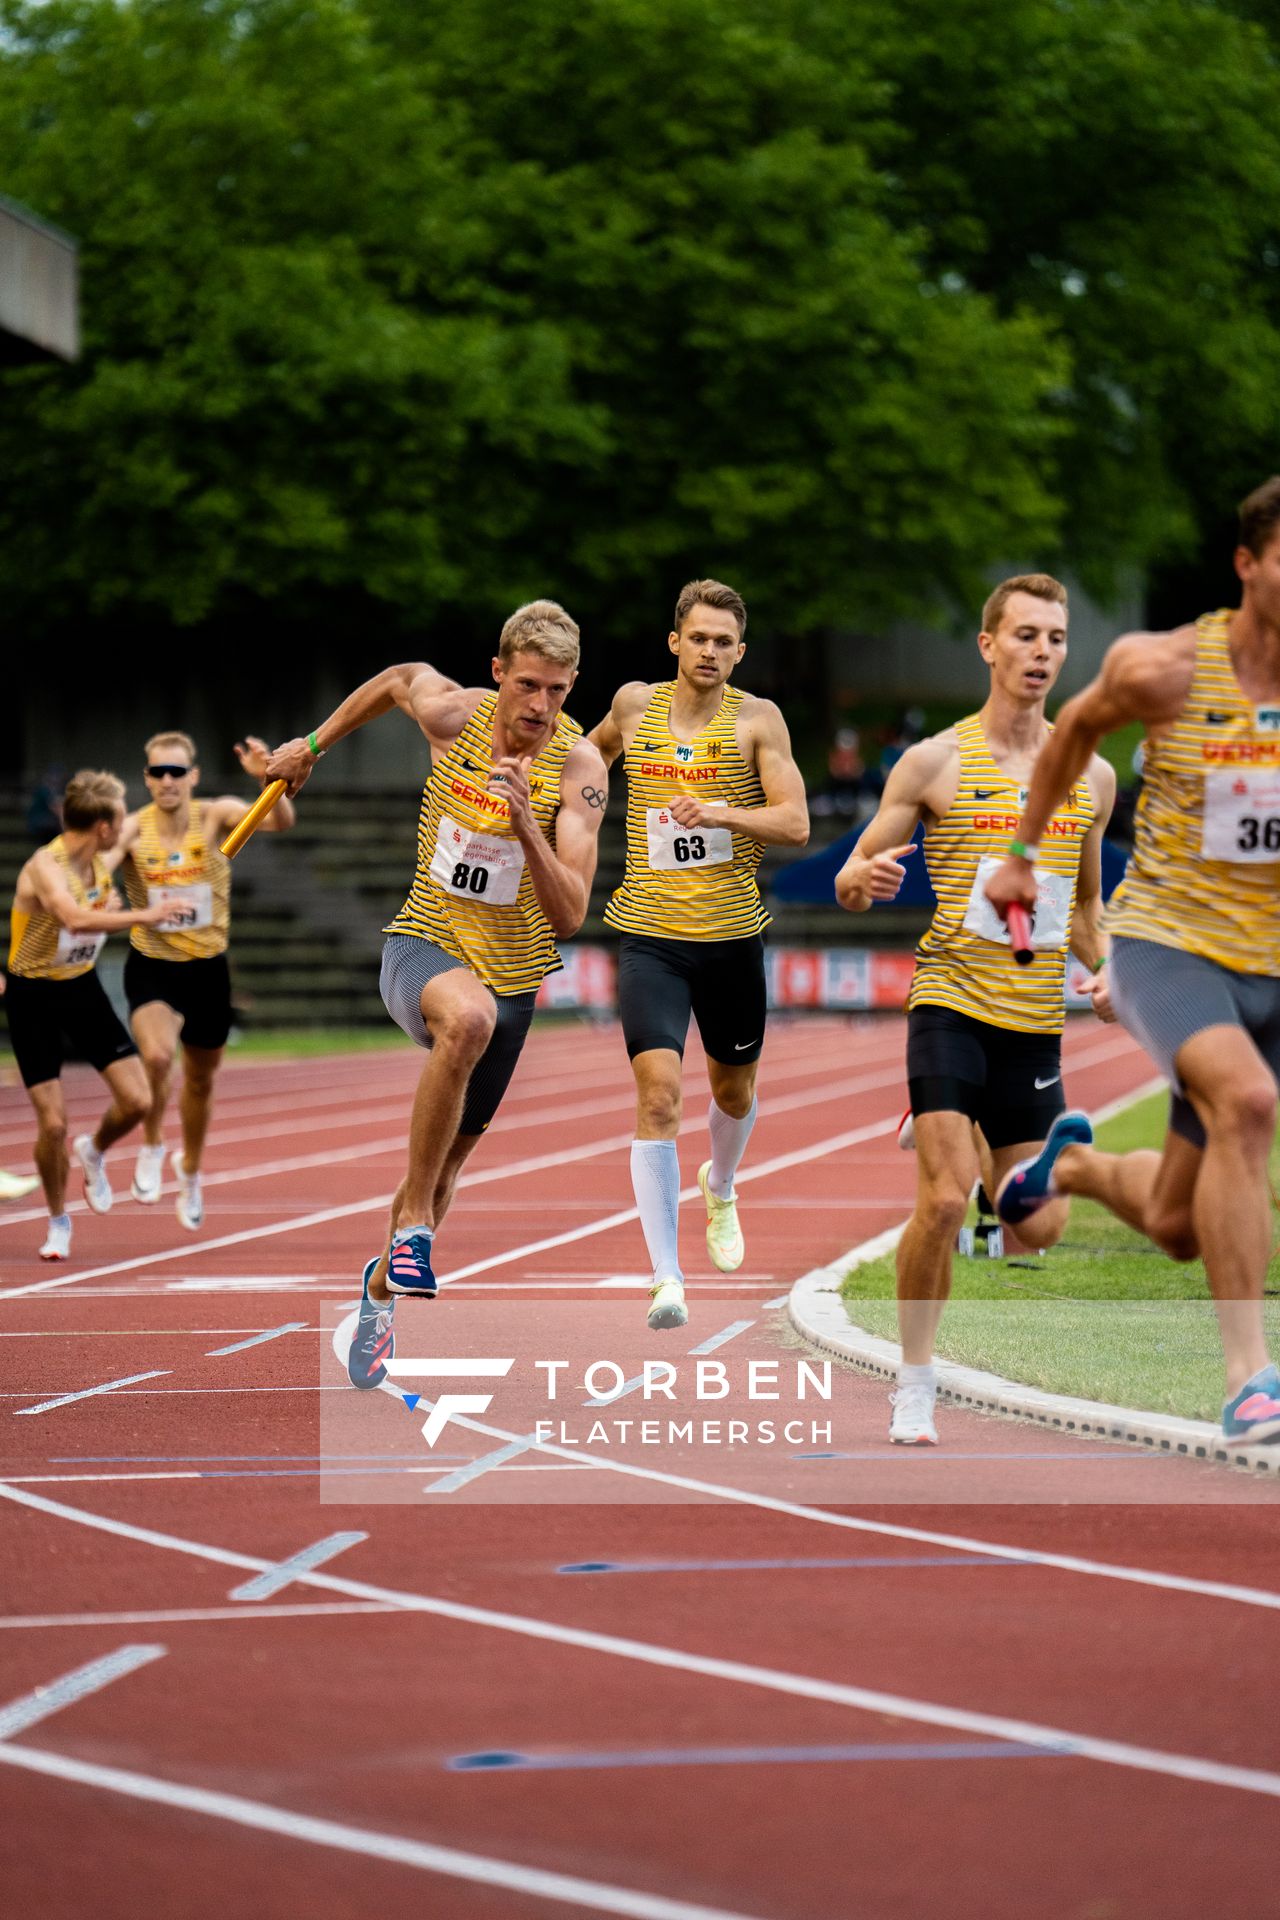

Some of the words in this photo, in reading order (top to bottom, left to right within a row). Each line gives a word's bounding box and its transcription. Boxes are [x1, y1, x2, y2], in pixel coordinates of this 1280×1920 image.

[641, 763, 719, 781] GERMANY
[450, 779, 512, 818] GERMA
[973, 815, 1080, 837] GERANY
[1237, 817, 1280, 852] 36
[463, 852, 508, 866] egensburg
[465, 840, 501, 855] parkasse
[673, 835, 706, 863] 63
[451, 862, 489, 894] 80
